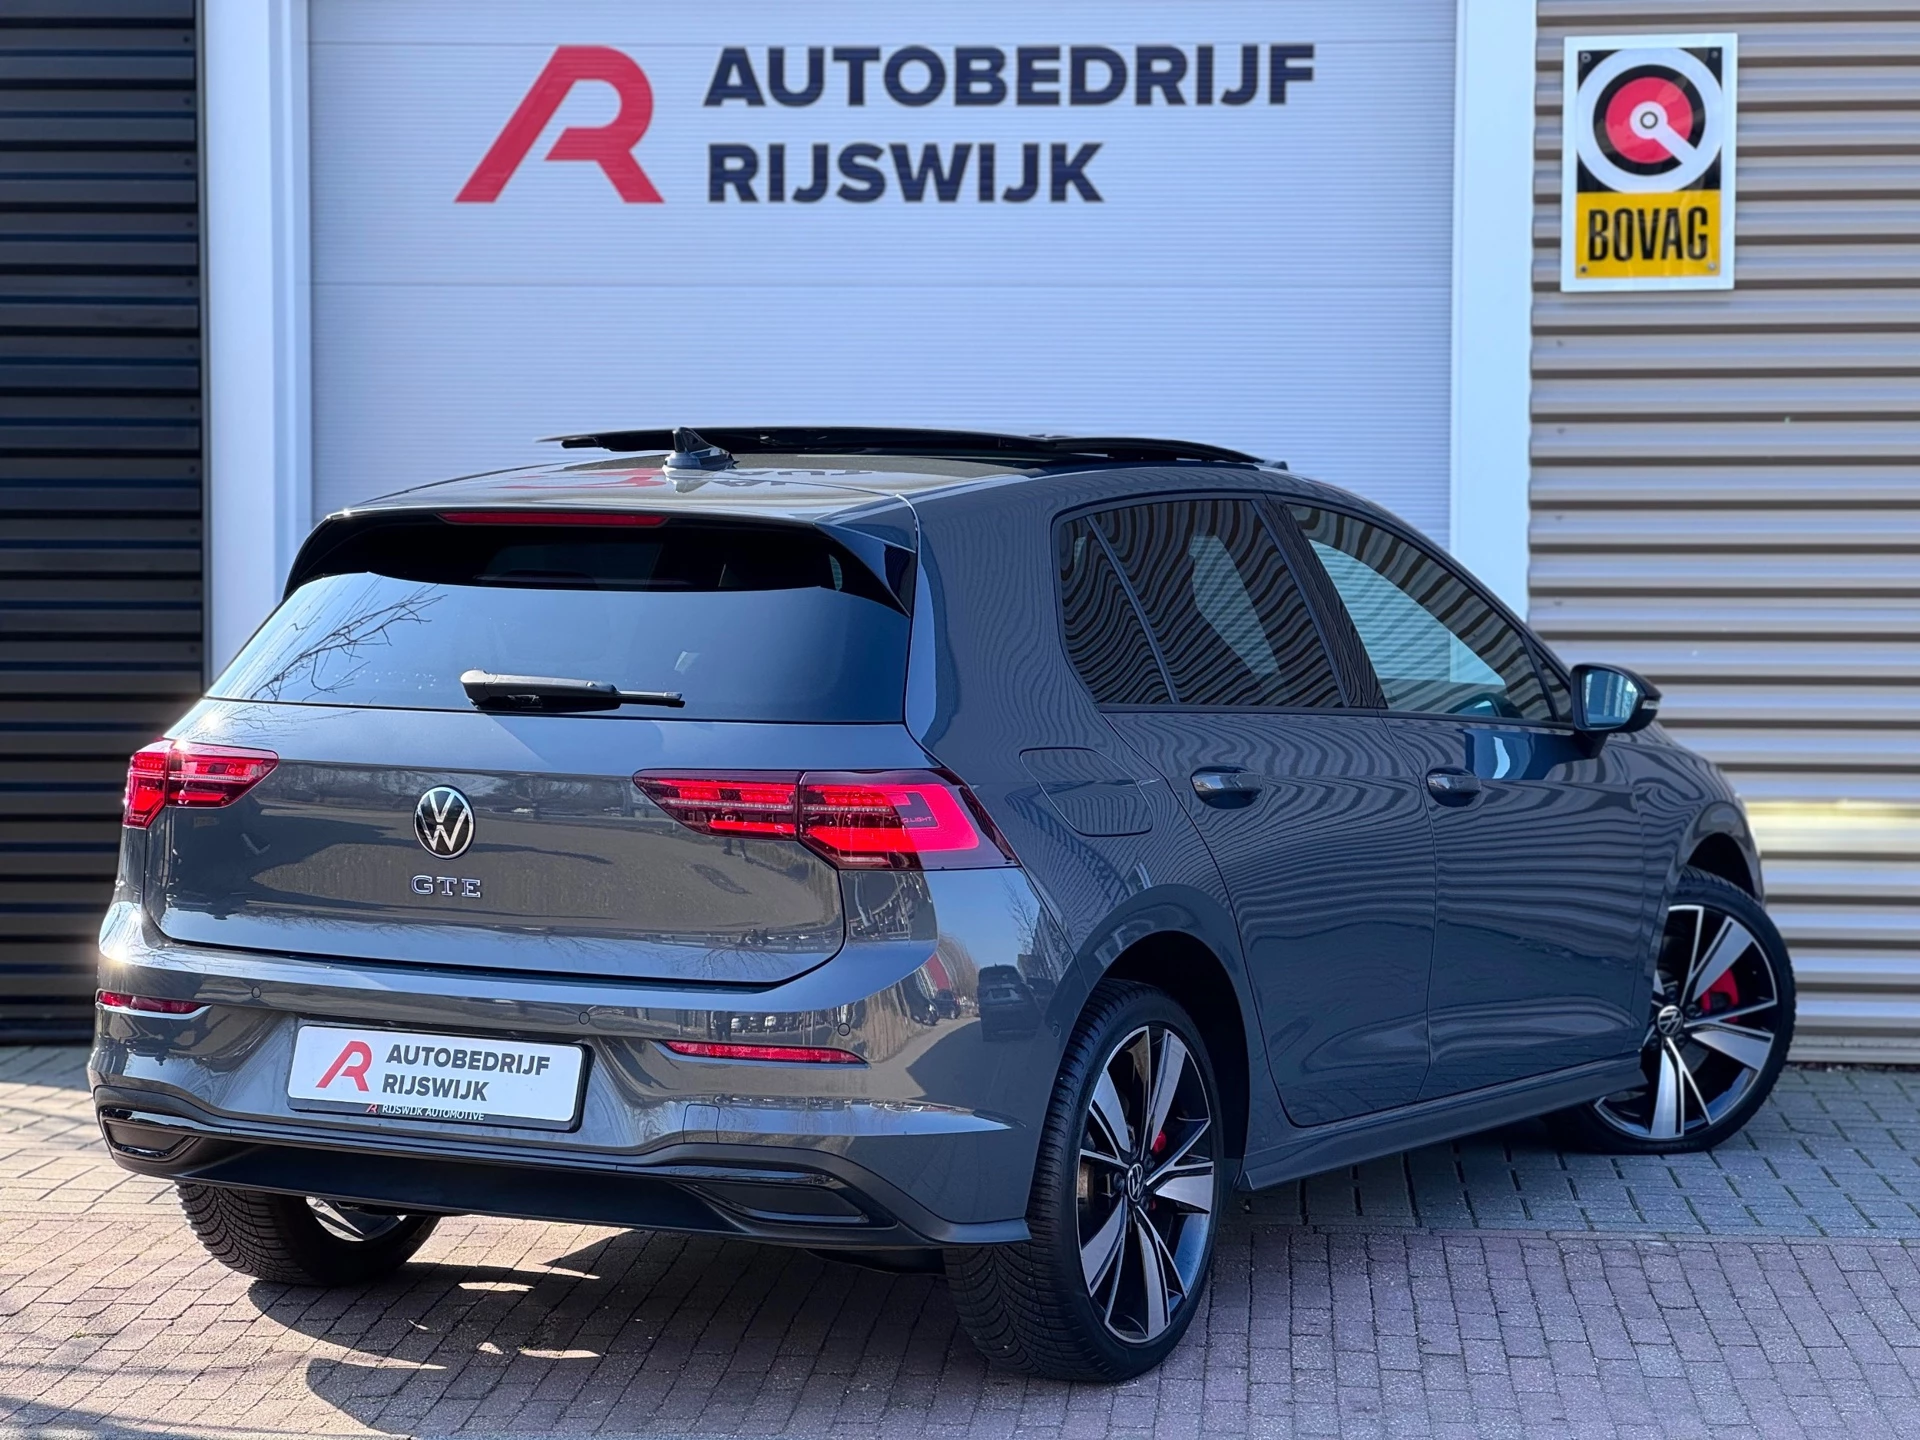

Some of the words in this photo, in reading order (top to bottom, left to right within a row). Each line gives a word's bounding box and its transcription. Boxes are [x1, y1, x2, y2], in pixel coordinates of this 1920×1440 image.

[703, 44, 1315, 107] AUTOBEDRIJF
[708, 143, 1103, 204] RIJSWIJK
[1588, 206, 1708, 262] BOVAG
[410, 874, 481, 898] GTE
[385, 1044, 551, 1076] AUTOBEDRIJF
[381, 1073, 490, 1102] RIJSWIJK
[382, 1104, 423, 1116] RIJSWIJK
[425, 1107, 485, 1120] AUTOMOTIVE
